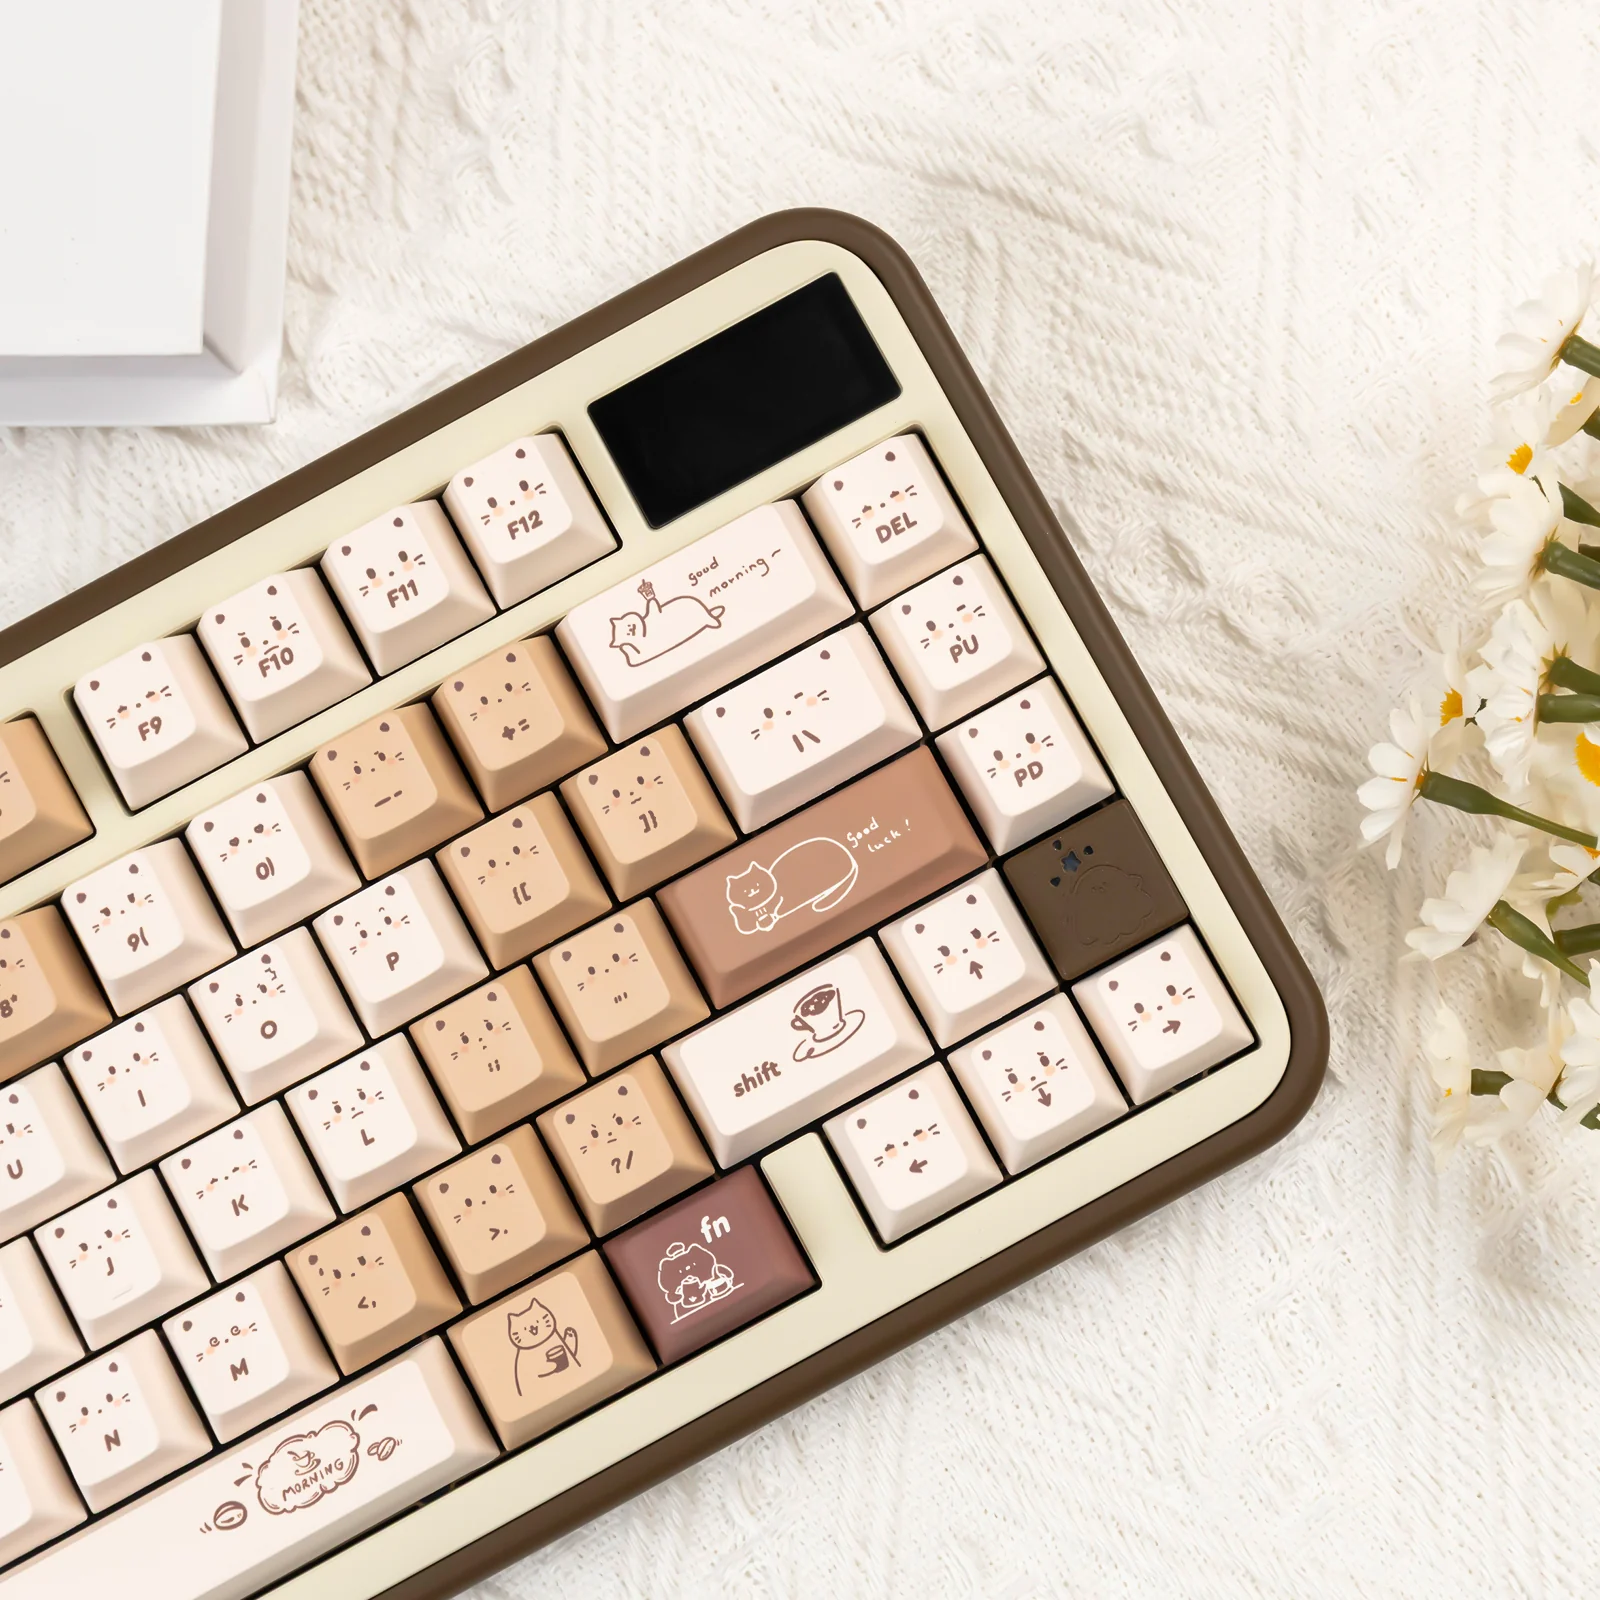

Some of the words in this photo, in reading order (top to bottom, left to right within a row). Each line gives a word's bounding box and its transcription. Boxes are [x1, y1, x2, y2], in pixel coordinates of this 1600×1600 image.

[508, 510, 543, 540] F12
[875, 512, 917, 543] DEL
[688, 556, 719, 586] good
[387, 578, 418, 608] F11
[258, 647, 293, 677] F10
[949, 635, 978, 663] PU
[137, 716, 162, 741] F9
[1014, 761, 1043, 787] PD
[846, 817, 879, 848] good
[386, 952, 400, 971] P
[261, 1021, 277, 1039] O
[733, 1062, 781, 1097] shift
[360, 1129, 375, 1146] L
[6, 1160, 23, 1179] U
[232, 1195, 248, 1216] K
[701, 1216, 731, 1243] fn
[106, 1257, 114, 1276] J
[229, 1358, 249, 1381] M
[104, 1430, 121, 1451] N
[282, 1458, 344, 1502] MORNING
